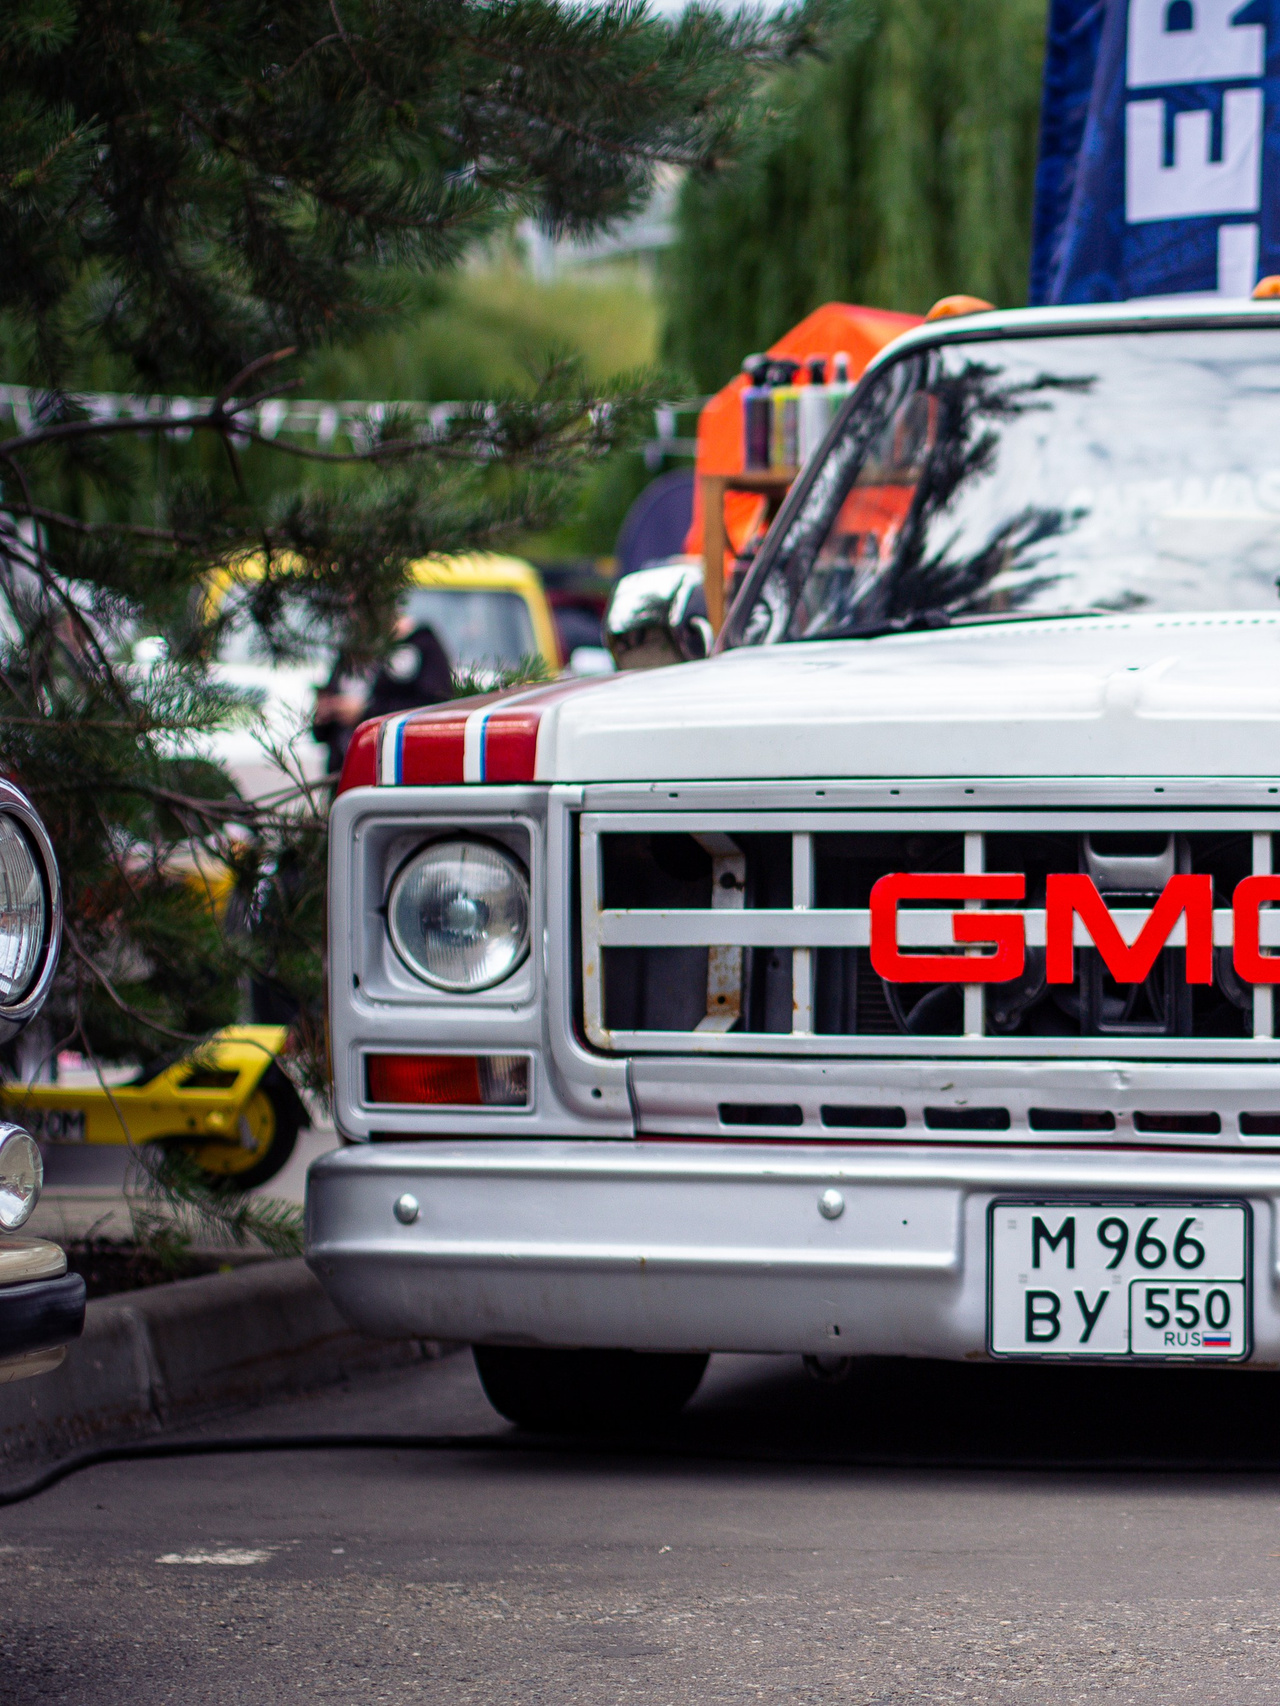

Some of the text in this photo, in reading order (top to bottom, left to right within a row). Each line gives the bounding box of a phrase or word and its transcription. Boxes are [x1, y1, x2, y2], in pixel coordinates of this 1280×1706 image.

[1096, 1216, 1206, 1270] 966
[1144, 1287, 1232, 1330] 550
[1164, 1331, 1202, 1347] RUS
